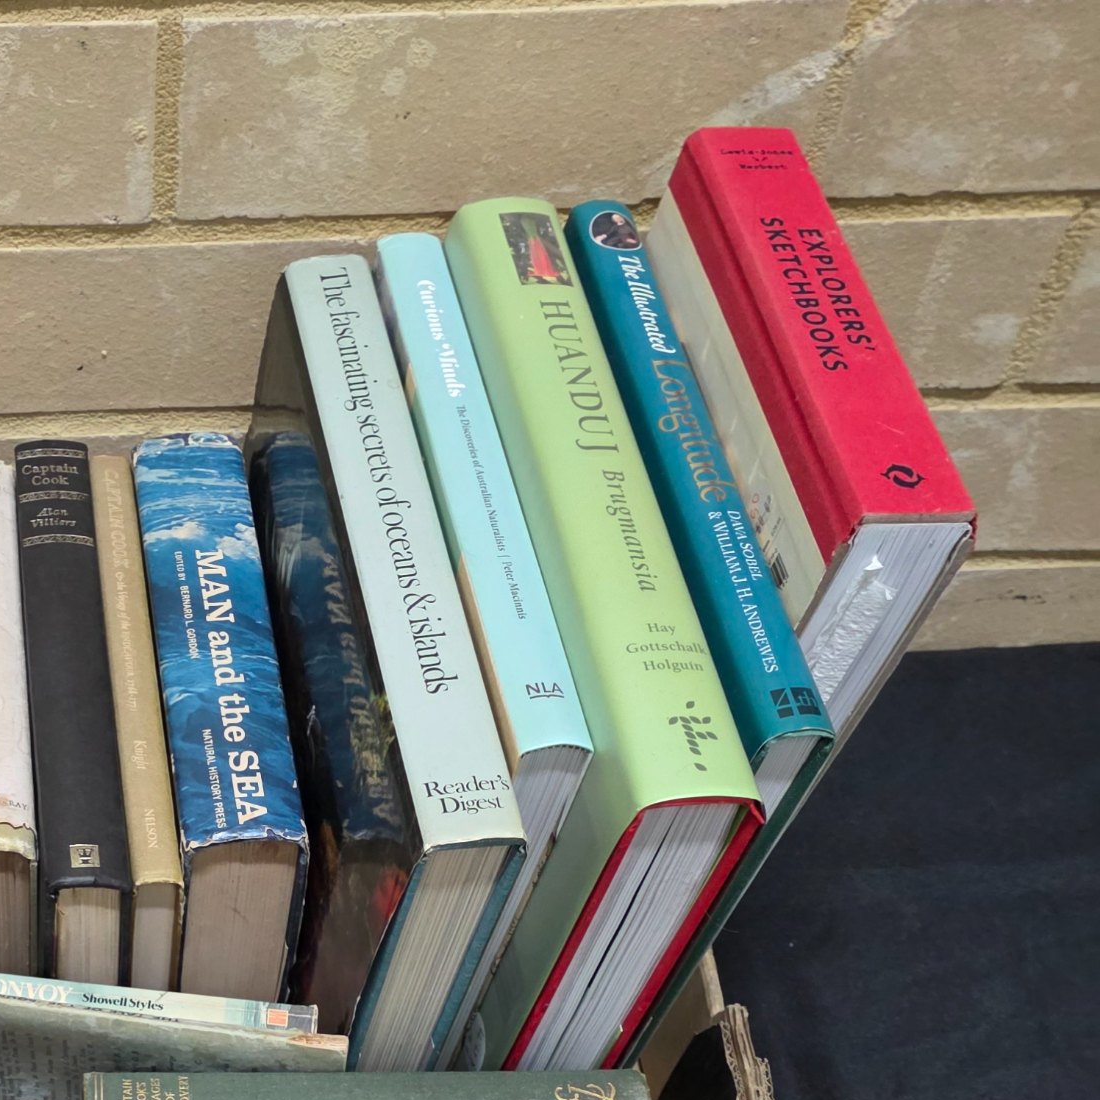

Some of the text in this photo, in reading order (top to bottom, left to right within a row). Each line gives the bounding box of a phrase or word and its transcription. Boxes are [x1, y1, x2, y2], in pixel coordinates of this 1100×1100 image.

[761, 217, 848, 372] SKETCHBOOKS
[798, 228, 878, 352] EXPLORERS'
[417, 280, 444, 341] Curious
[437, 343, 466, 398] Minds
[618, 255, 738, 503] The Illustrated Longitude
[456, 405, 467, 419] The
[459, 419, 478, 459] Discoveries
[540, 300, 657, 592] HUANDUJ Brugmansia
[21, 464, 79, 477] Captain
[31, 475, 69, 486] Cook
[320, 267, 458, 695] The fascinating secrets of oceans & islands
[475, 468, 492, 508] Australian
[30, 517, 77, 529] Villiers
[37, 507, 68, 518] Alan
[486, 509, 506, 552] Naturalists
[502, 561, 516, 582] Peter
[508, 580, 527, 621] Macinnis
[626, 641, 707, 655] Gottschalk
[647, 623, 676, 636] Hay
[195, 549, 268, 825] MAN and the SEA
[526, 682, 564, 697] NLA
[202, 729, 227, 829] NATURAL HISTORY PRESS
[424, 775, 511, 798] Reader's
[440, 795, 504, 815] Digest
[144, 808, 158, 848] NELSON
[82, 992, 129, 1010] Showell
[128, 997, 165, 1012] Styles
